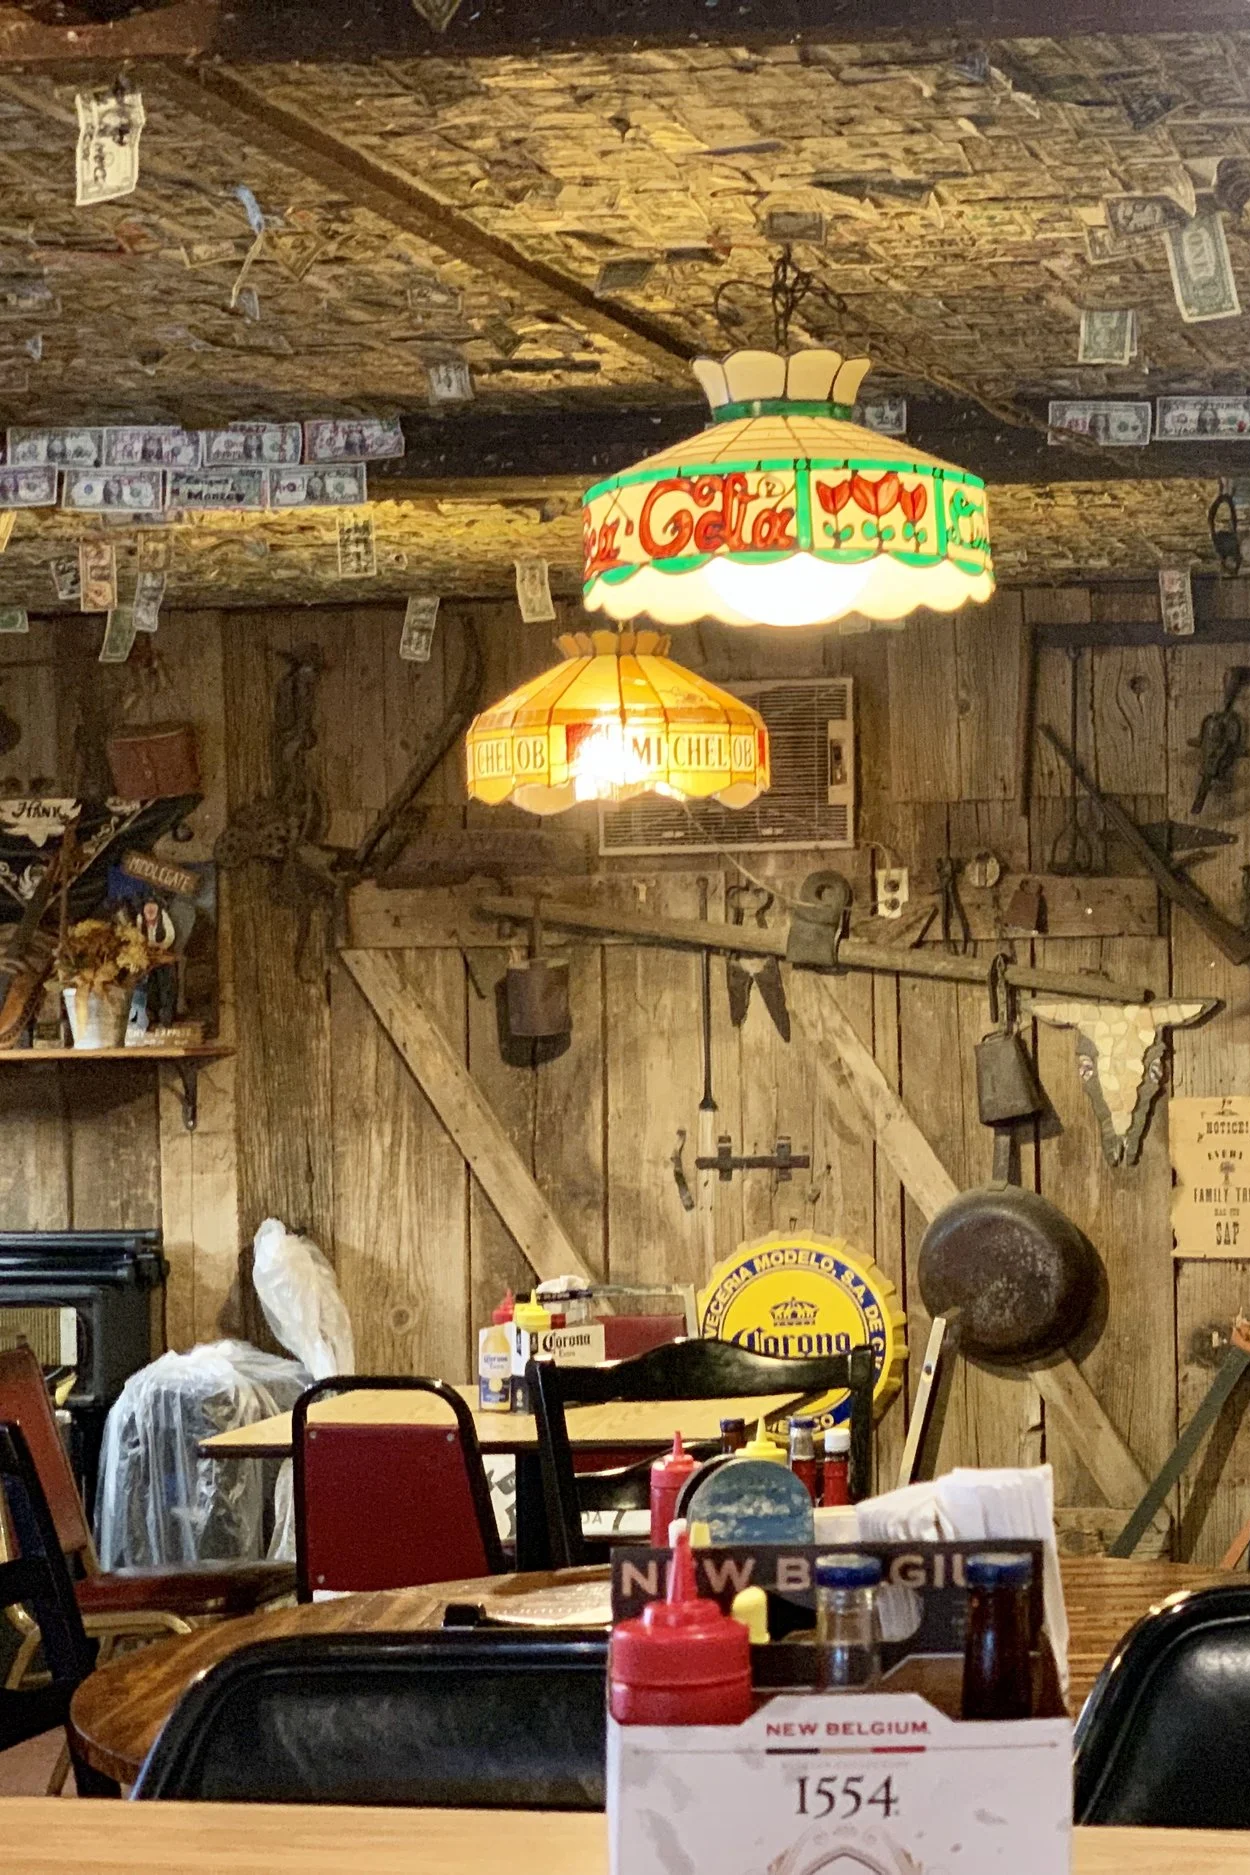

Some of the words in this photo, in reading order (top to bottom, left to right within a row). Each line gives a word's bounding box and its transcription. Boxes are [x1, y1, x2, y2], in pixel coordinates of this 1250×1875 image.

[632, 735, 754, 768] MICHELOB
[128, 857, 192, 892] MIDDLEGATE
[1206, 1121, 1249, 1135] NOTICE!
[1193, 1187, 1229, 1203] FAMILY
[1216, 1221, 1240, 1246] SAP
[703, 1267, 753, 1339] VECERIA
[753, 1249, 837, 1278] MODELO,
[840, 1271, 866, 1304] S.A.
[864, 1304, 882, 1332] DE
[542, 1331, 592, 1355] Corona
[731, 1326, 851, 1358] Corona
[483, 1354, 508, 1364] Corona
[620, 1558, 756, 1597] NW
[776, 1554, 968, 1592] BGIU
[766, 1722, 819, 1737] NEW
[825, 1721, 930, 1737] BELGIUM
[796, 1774, 899, 1820] 1554
